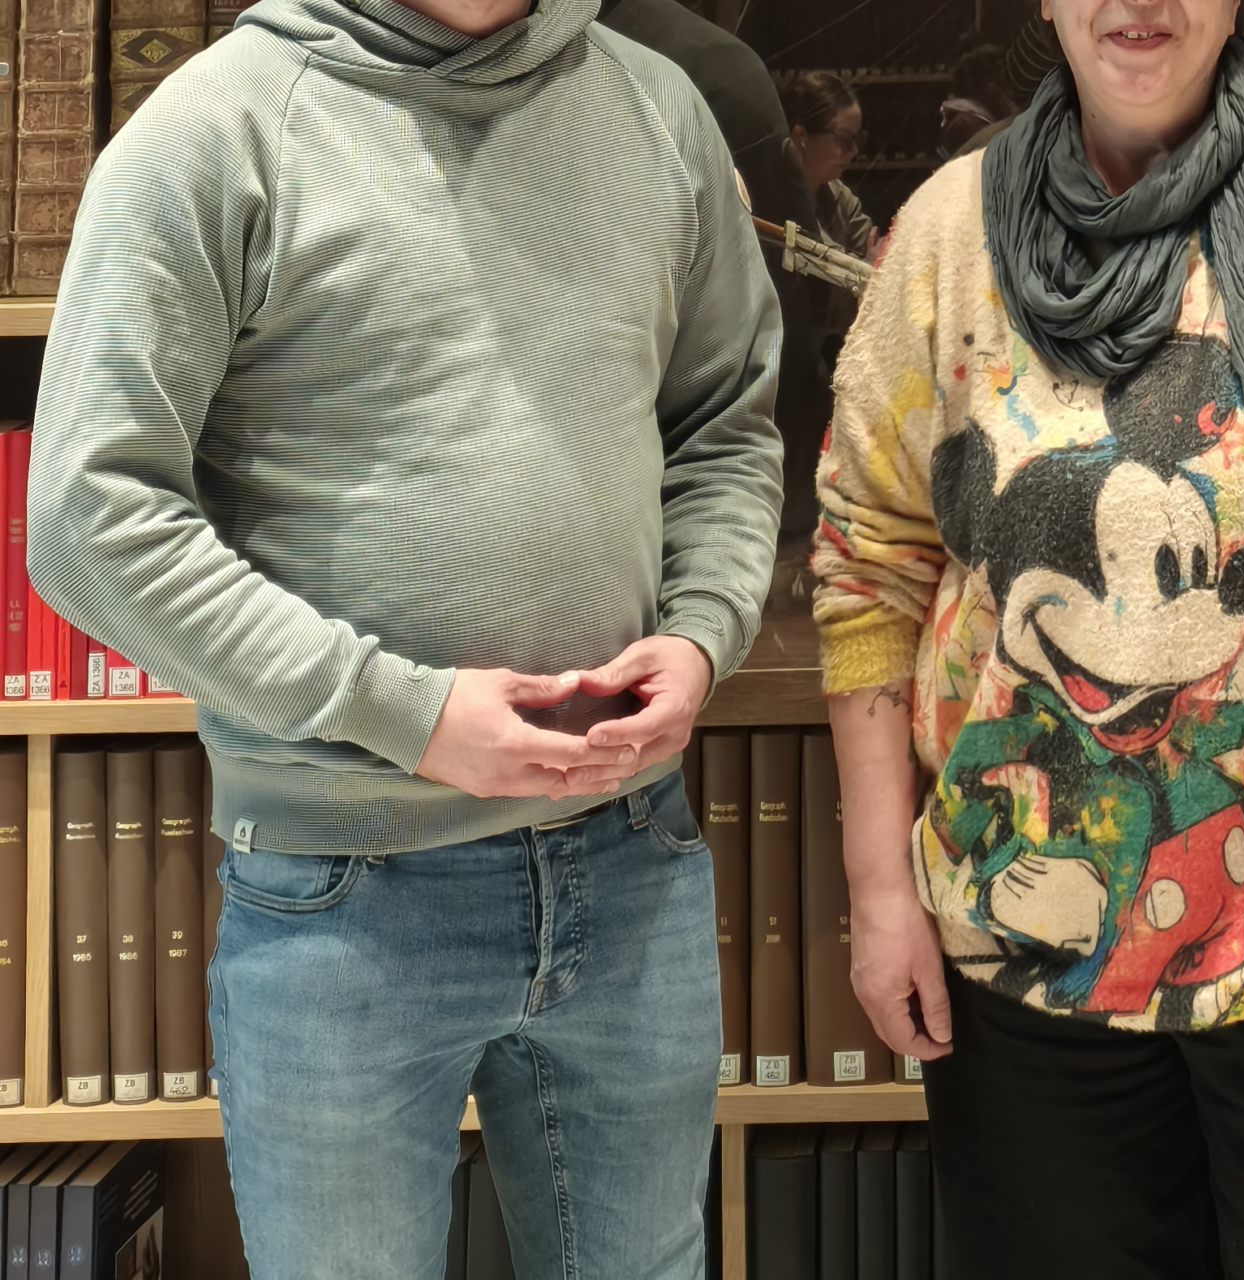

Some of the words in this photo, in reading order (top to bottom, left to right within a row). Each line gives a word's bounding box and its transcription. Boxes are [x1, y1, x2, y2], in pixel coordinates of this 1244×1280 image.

[92, 657, 101, 678] 1366
[34, 675, 48, 684] ZA
[118, 671, 130, 679] ZA
[8, 676, 20, 684] ZA
[31, 685, 50, 694] 1366
[92, 680, 101, 693] ZA
[114, 684, 134, 692] 1366
[124, 1079, 135, 1087] ZB
[173, 1076, 185, 1085] ZB
[77, 1081, 88, 1090] ZB
[169, 1085, 191, 1095] 462
